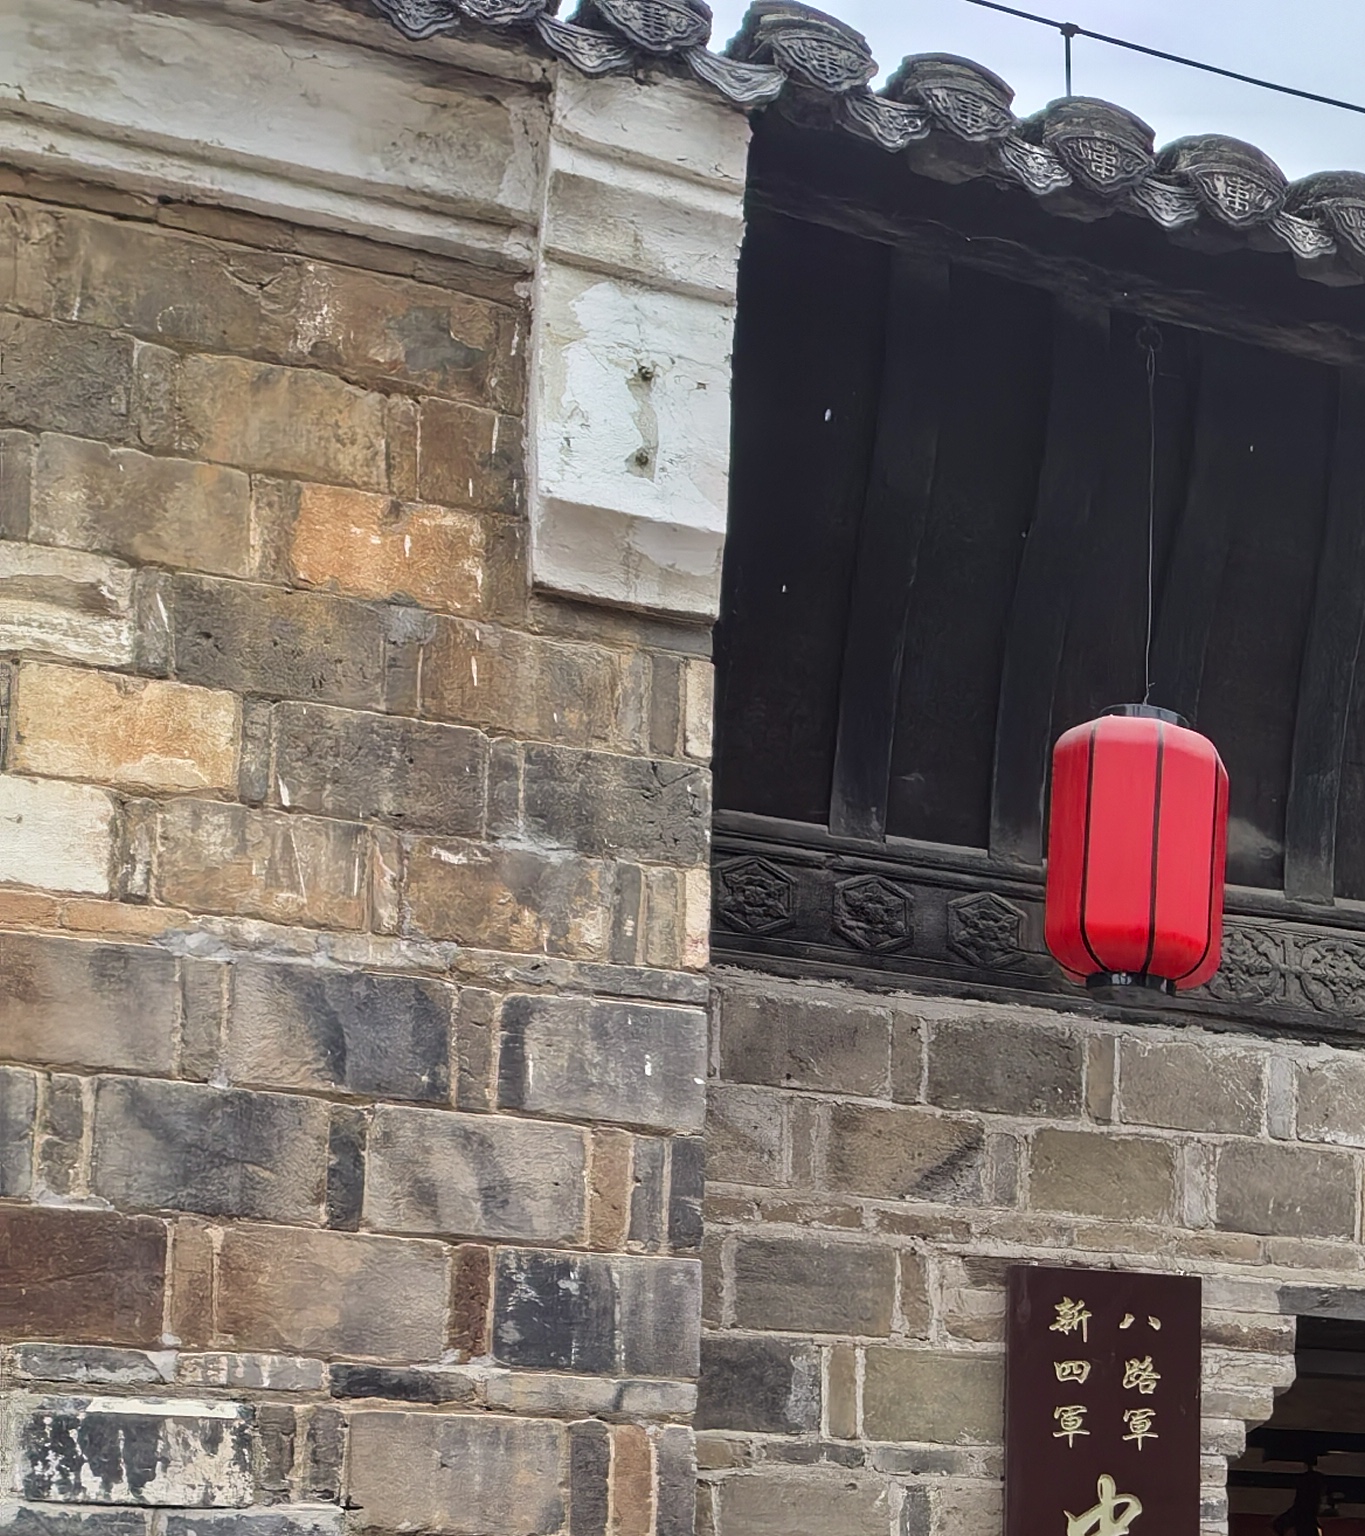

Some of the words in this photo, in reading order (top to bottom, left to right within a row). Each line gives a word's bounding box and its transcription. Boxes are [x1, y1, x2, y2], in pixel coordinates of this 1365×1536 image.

[1049, 1296, 1092, 1450] 新四軍
[1119, 1311, 1162, 1453] 八路軍
